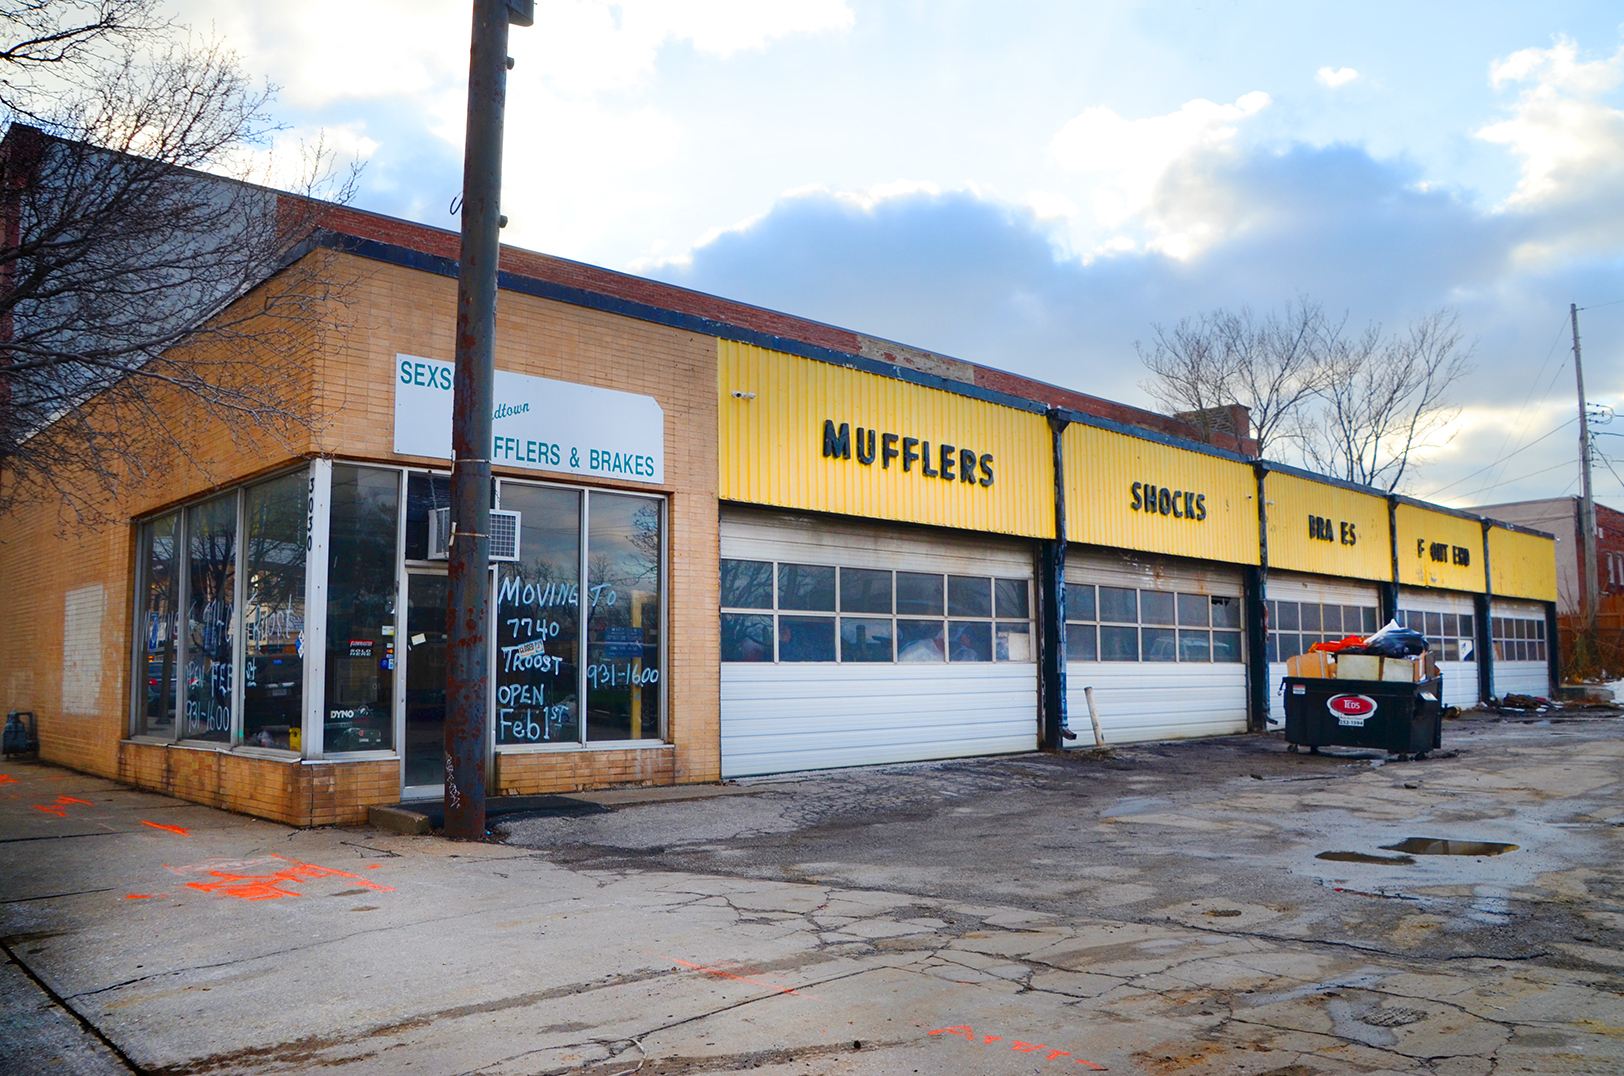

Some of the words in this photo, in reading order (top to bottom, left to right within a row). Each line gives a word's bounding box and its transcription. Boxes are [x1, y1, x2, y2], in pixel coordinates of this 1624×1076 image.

[400, 361, 455, 391] SEXS
[492, 403, 530, 420] dtown
[494, 435, 561, 466] FFLERS
[569, 446, 581, 468] &
[589, 448, 655, 477] BRAKES
[822, 419, 995, 487] MUFFLERS
[307, 477, 315, 552] 3030
[1131, 481, 1207, 521] SHOCKS
[1308, 514, 1357, 546] BRAES
[498, 576, 579, 607] MOVING
[507, 618, 560, 641] 7740
[501, 645, 563, 675] TROOST
[588, 663, 660, 689] 931-1600
[498, 683, 545, 706] OPEN
[186, 700, 230, 733] 931-1600
[500, 708, 541, 740] Feb
